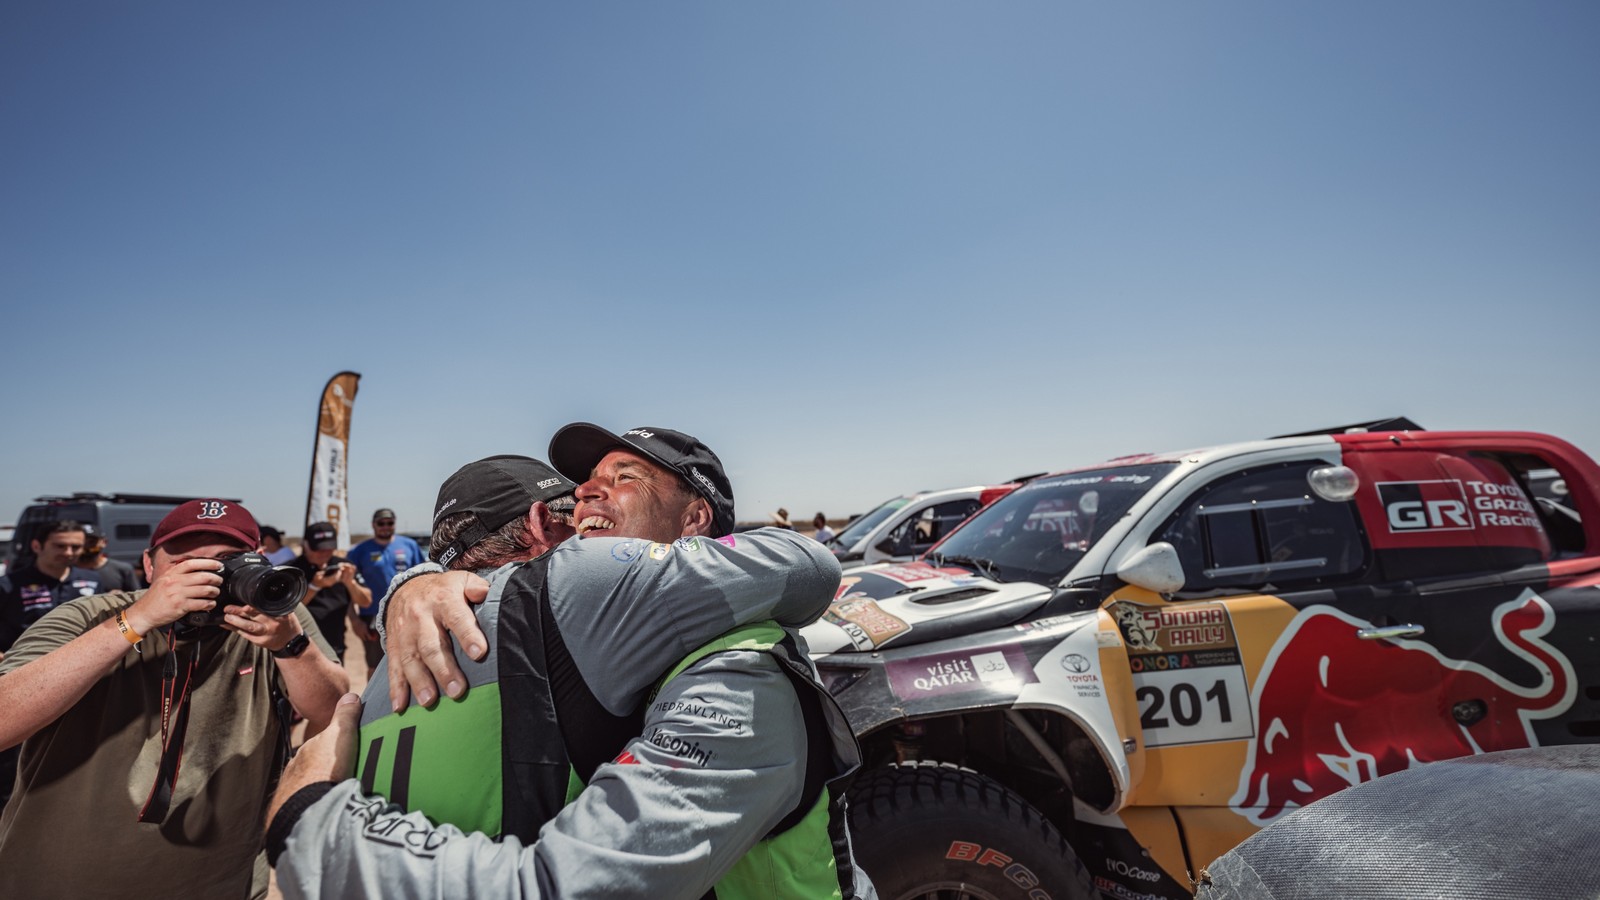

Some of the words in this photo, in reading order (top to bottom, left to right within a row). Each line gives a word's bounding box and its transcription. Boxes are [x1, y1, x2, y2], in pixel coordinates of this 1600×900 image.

[537, 477, 562, 490] sparco
[691, 466, 716, 495] sparco
[1466, 481, 1525, 500] TOYOT
[1387, 500, 1469, 529] GR
[845, 624, 869, 646] 201
[926, 659, 968, 676] visit
[1130, 653, 1194, 673] ONORA
[913, 670, 976, 691] QATAR
[1066, 674, 1099, 684] TOYOTA
[1135, 679, 1232, 730] 201
[652, 701, 743, 731] PIEDRAVLANCA
